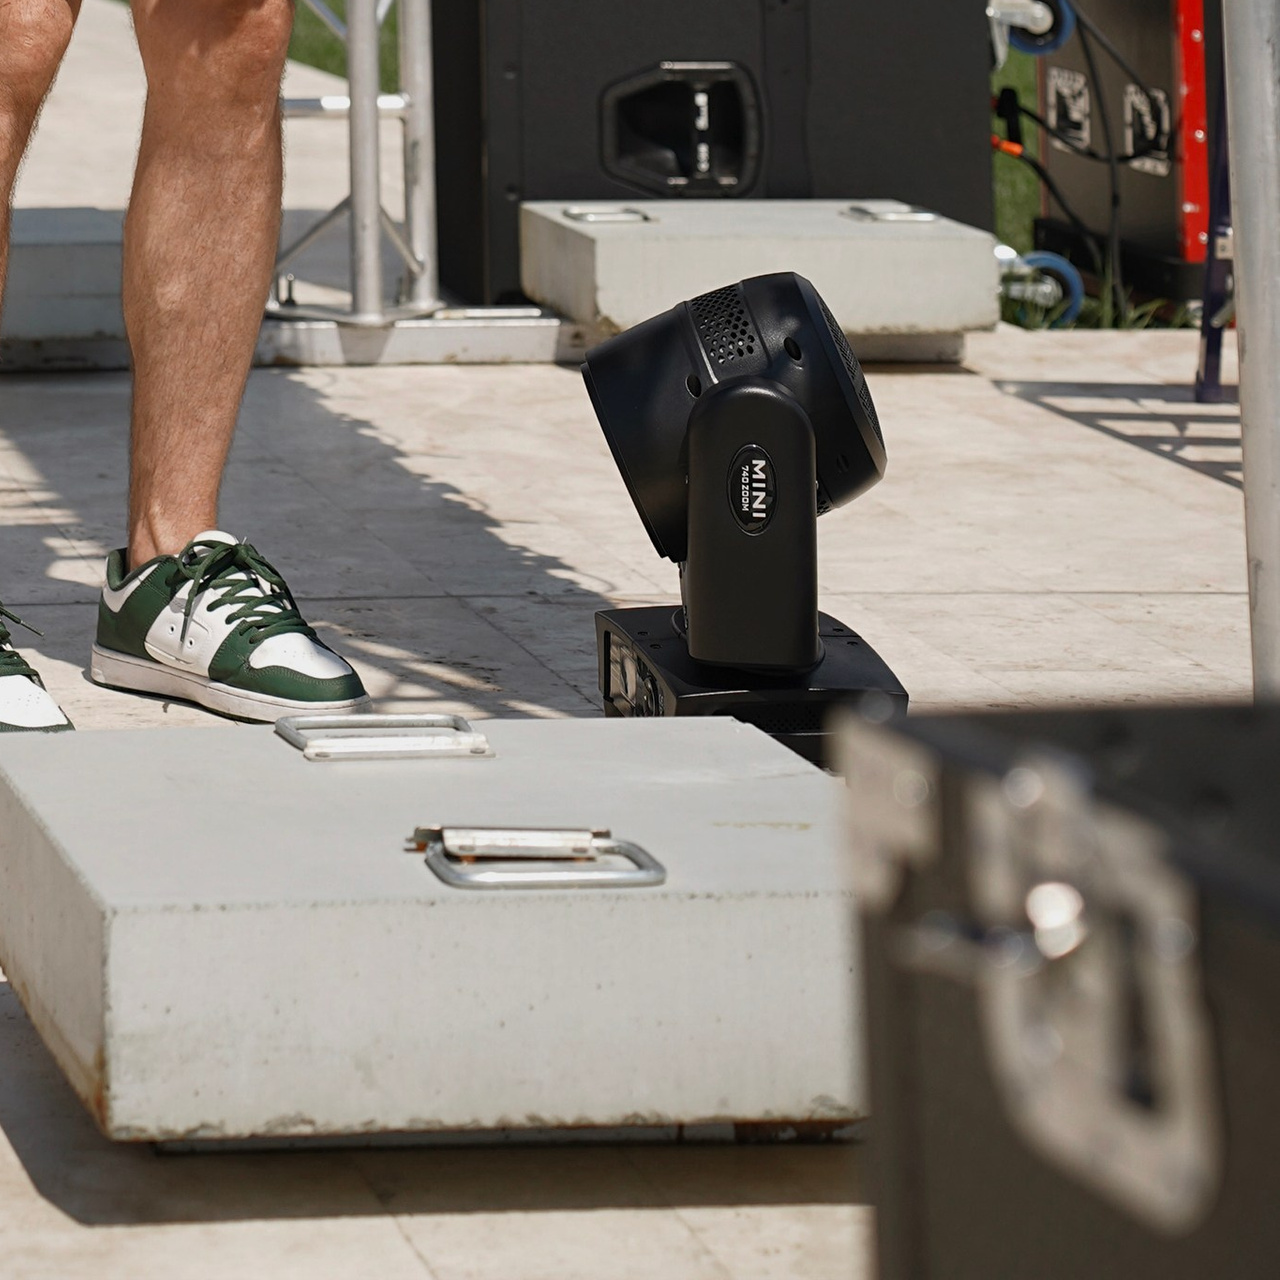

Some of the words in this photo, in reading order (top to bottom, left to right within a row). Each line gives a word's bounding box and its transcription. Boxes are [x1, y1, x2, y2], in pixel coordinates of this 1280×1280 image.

[741, 465, 750, 484] 740
[741, 485, 750, 512] ZOOM
[752, 459, 767, 518] MINI
